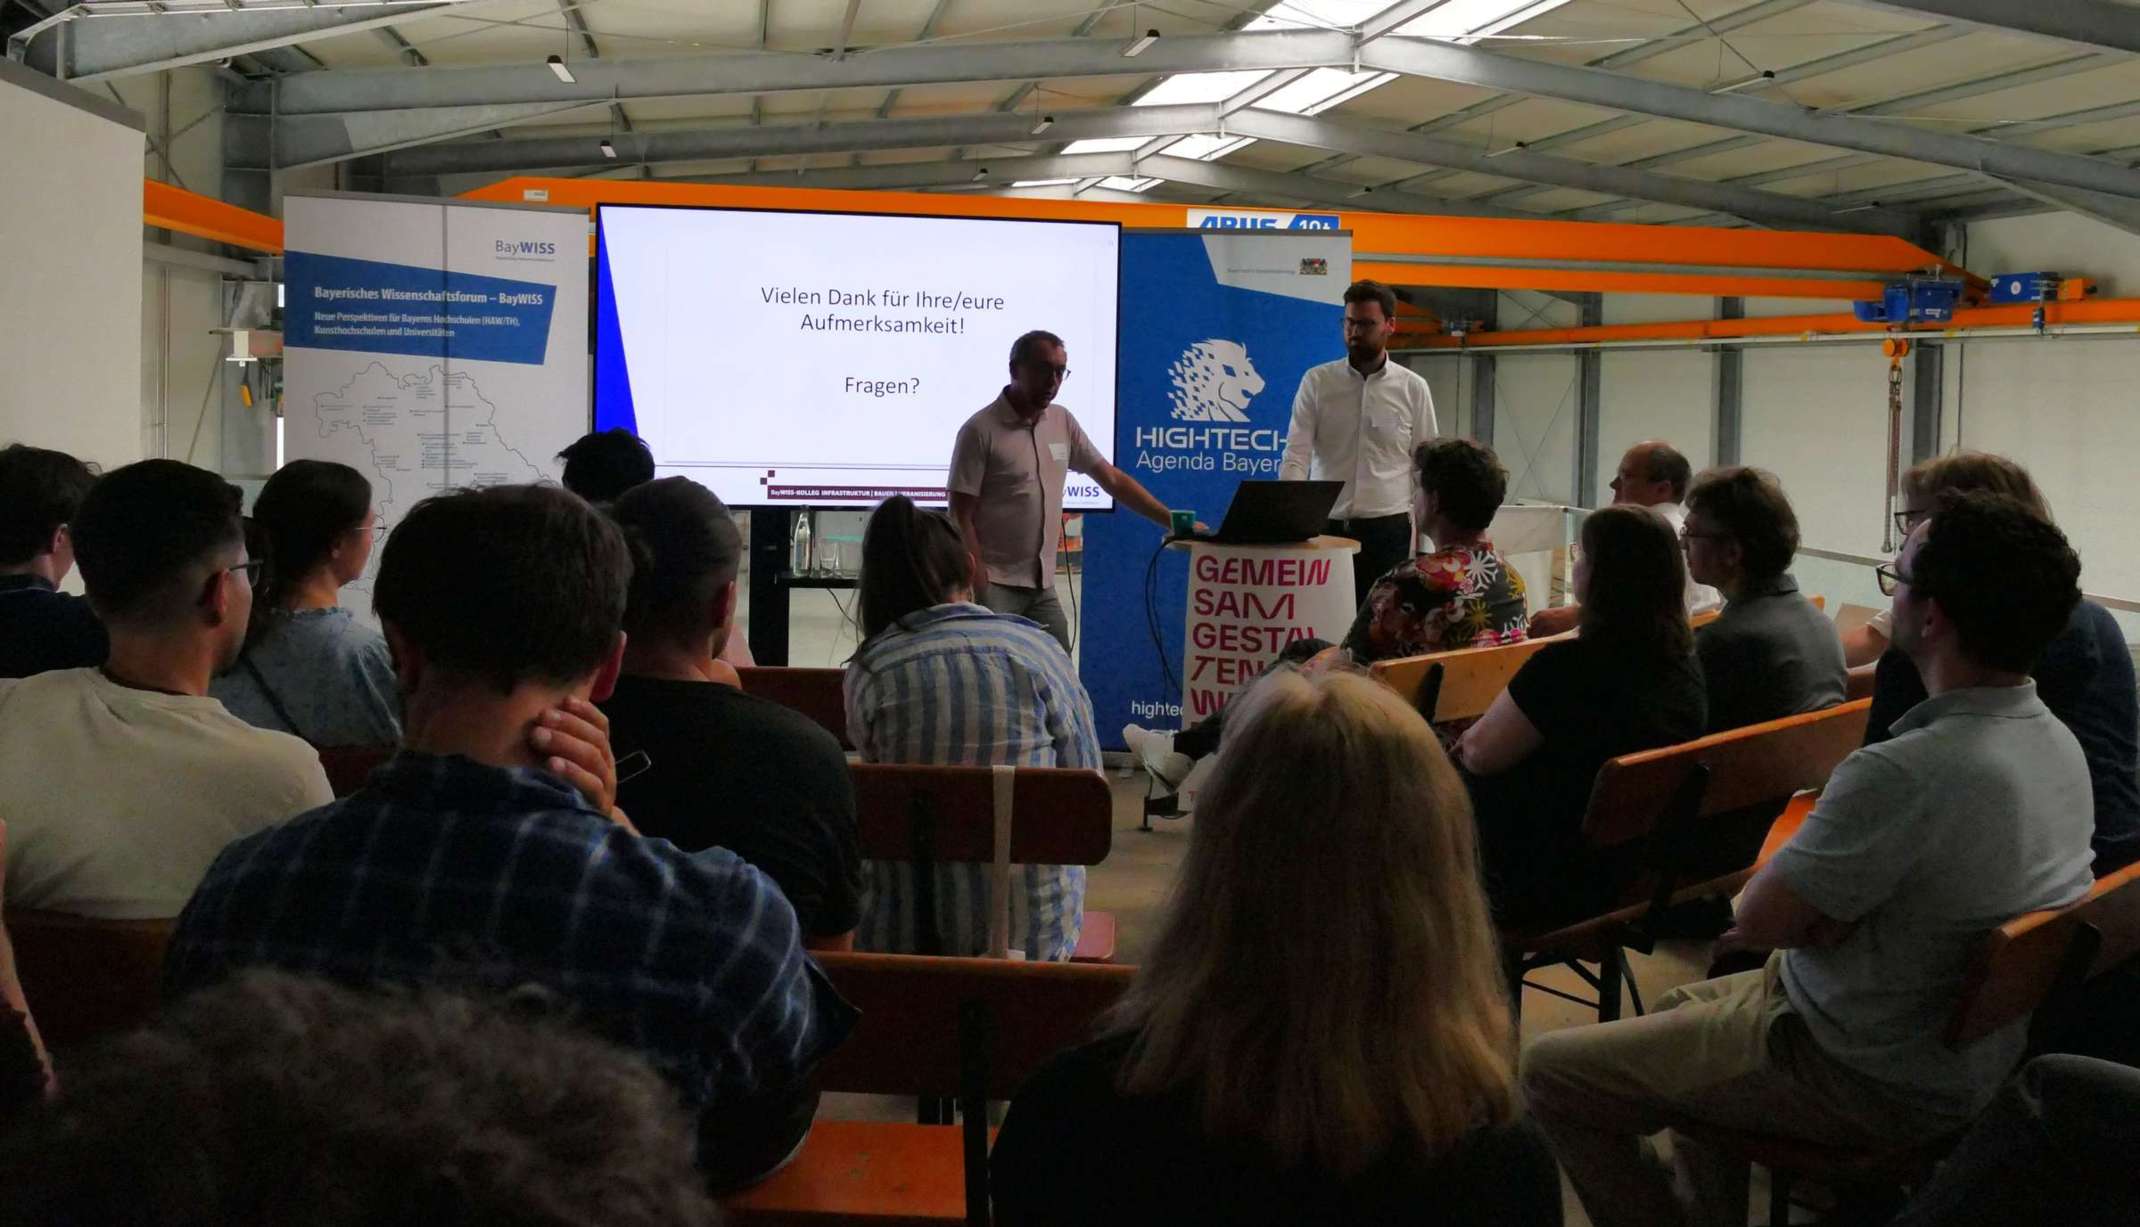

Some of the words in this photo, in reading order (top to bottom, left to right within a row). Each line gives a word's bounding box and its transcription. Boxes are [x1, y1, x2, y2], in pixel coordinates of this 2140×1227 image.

[495, 239, 556, 256] BayWISS
[314, 286, 379, 301] Bayerisches
[381, 288, 487, 303] Wissenschaftsforum
[499, 293, 543, 306] BayWISS
[761, 286, 821, 306] Vielen
[828, 288, 876, 307] Dank
[882, 289, 910, 308] für
[916, 290, 1005, 312] Ihre/eure
[314, 311, 336, 321] Neue
[337, 312, 388, 324] Perspektiven
[389, 313, 400, 322] für
[433, 314, 481, 325] Hochschulen
[800, 313, 964, 334] Aufmerksamkeit!
[314, 325, 386, 336] Kunsthochschulen
[387, 327, 402, 336] und
[403, 327, 455, 337] Universitäten
[845, 376, 920, 398] Fragen?
[1136, 427, 1289, 451] HIGHTECH
[1136, 451, 1214, 474] Agenda
[1223, 452, 1281, 476] Bayer
[1196, 555, 1332, 587] GEMEIN
[1194, 589, 1294, 620] SAM
[1191, 656, 1264, 685] TEN
